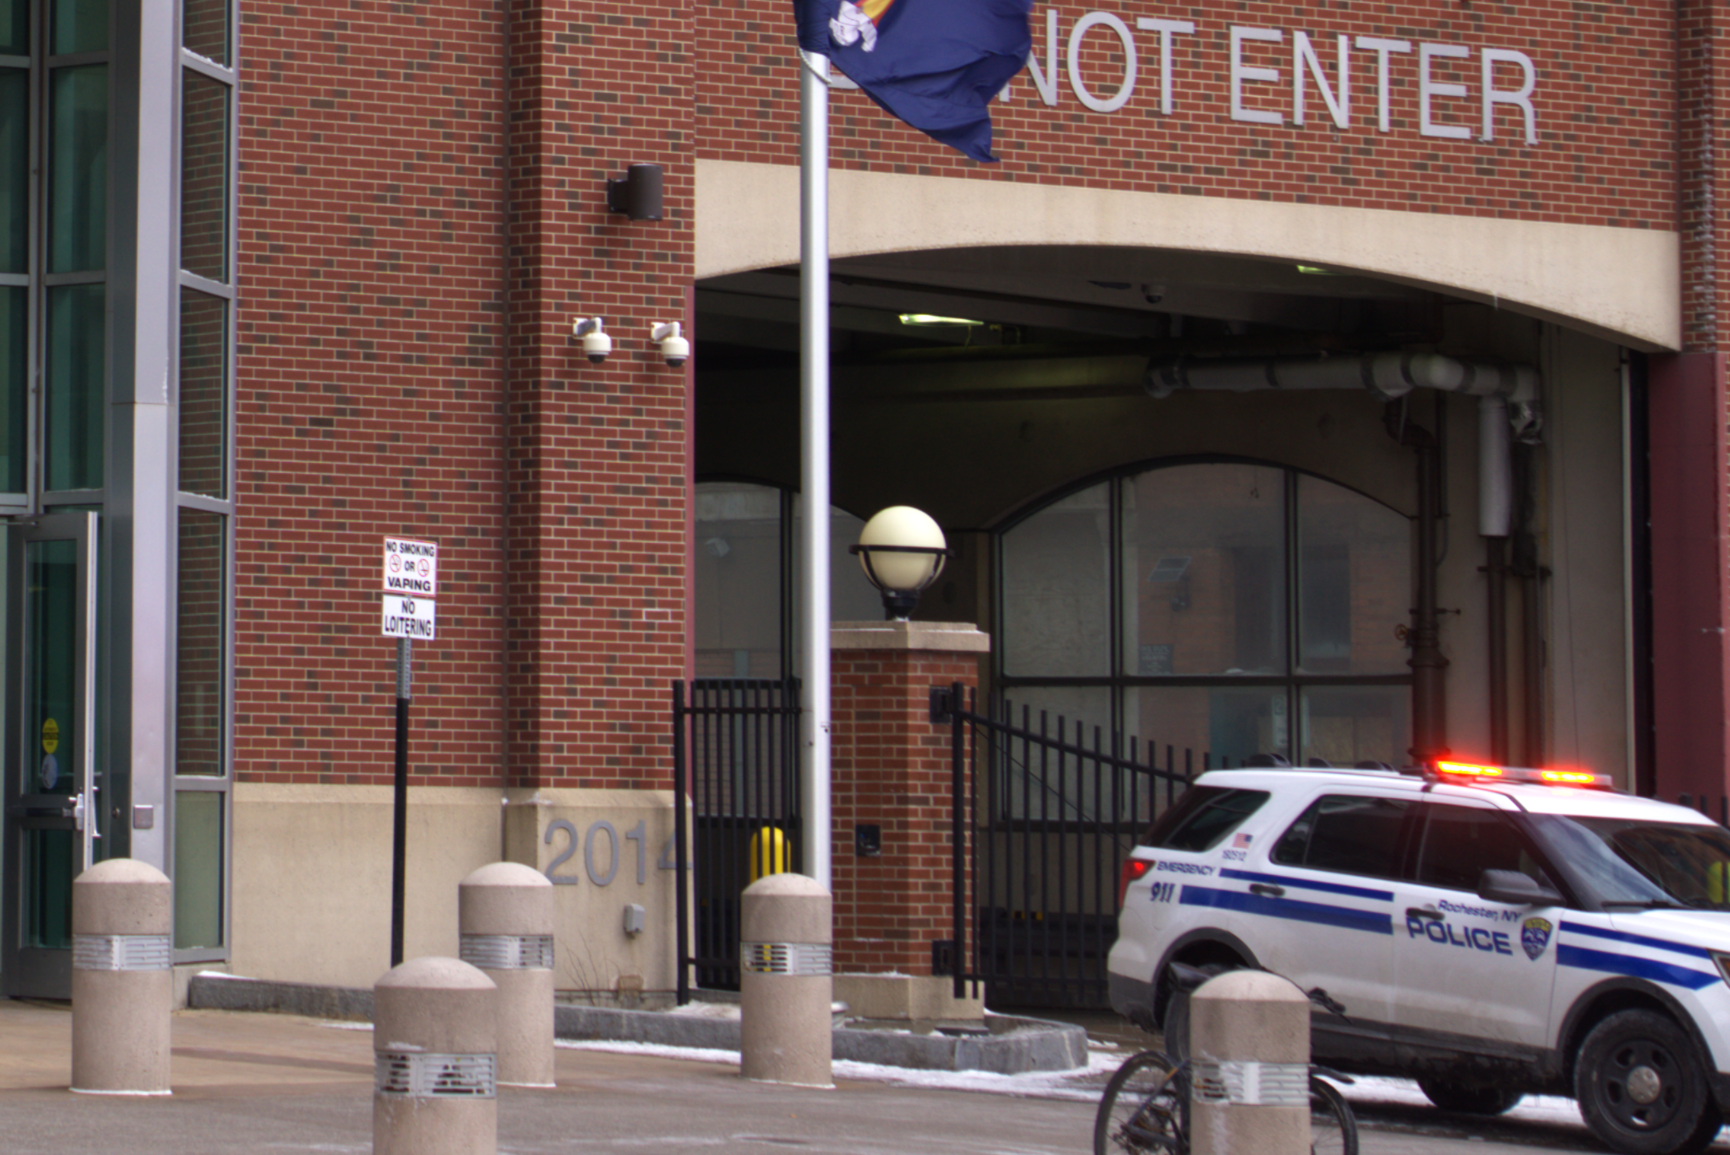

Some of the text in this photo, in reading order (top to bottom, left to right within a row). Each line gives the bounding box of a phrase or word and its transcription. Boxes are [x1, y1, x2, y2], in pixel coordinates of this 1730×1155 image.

[999, 8, 1539, 145] NOT ENTER
[386, 541, 435, 558] NO SMOKING
[404, 560, 415, 573] OR
[387, 576, 432, 592] VAPING
[401, 600, 416, 615] NO
[384, 615, 432, 637] LOITERING
[1157, 861, 1216, 877] EMERGENCY
[1150, 881, 1175, 903] 911
[1438, 899, 1523, 923] Rochester, NY
[1406, 916, 1513, 956] POLICE
